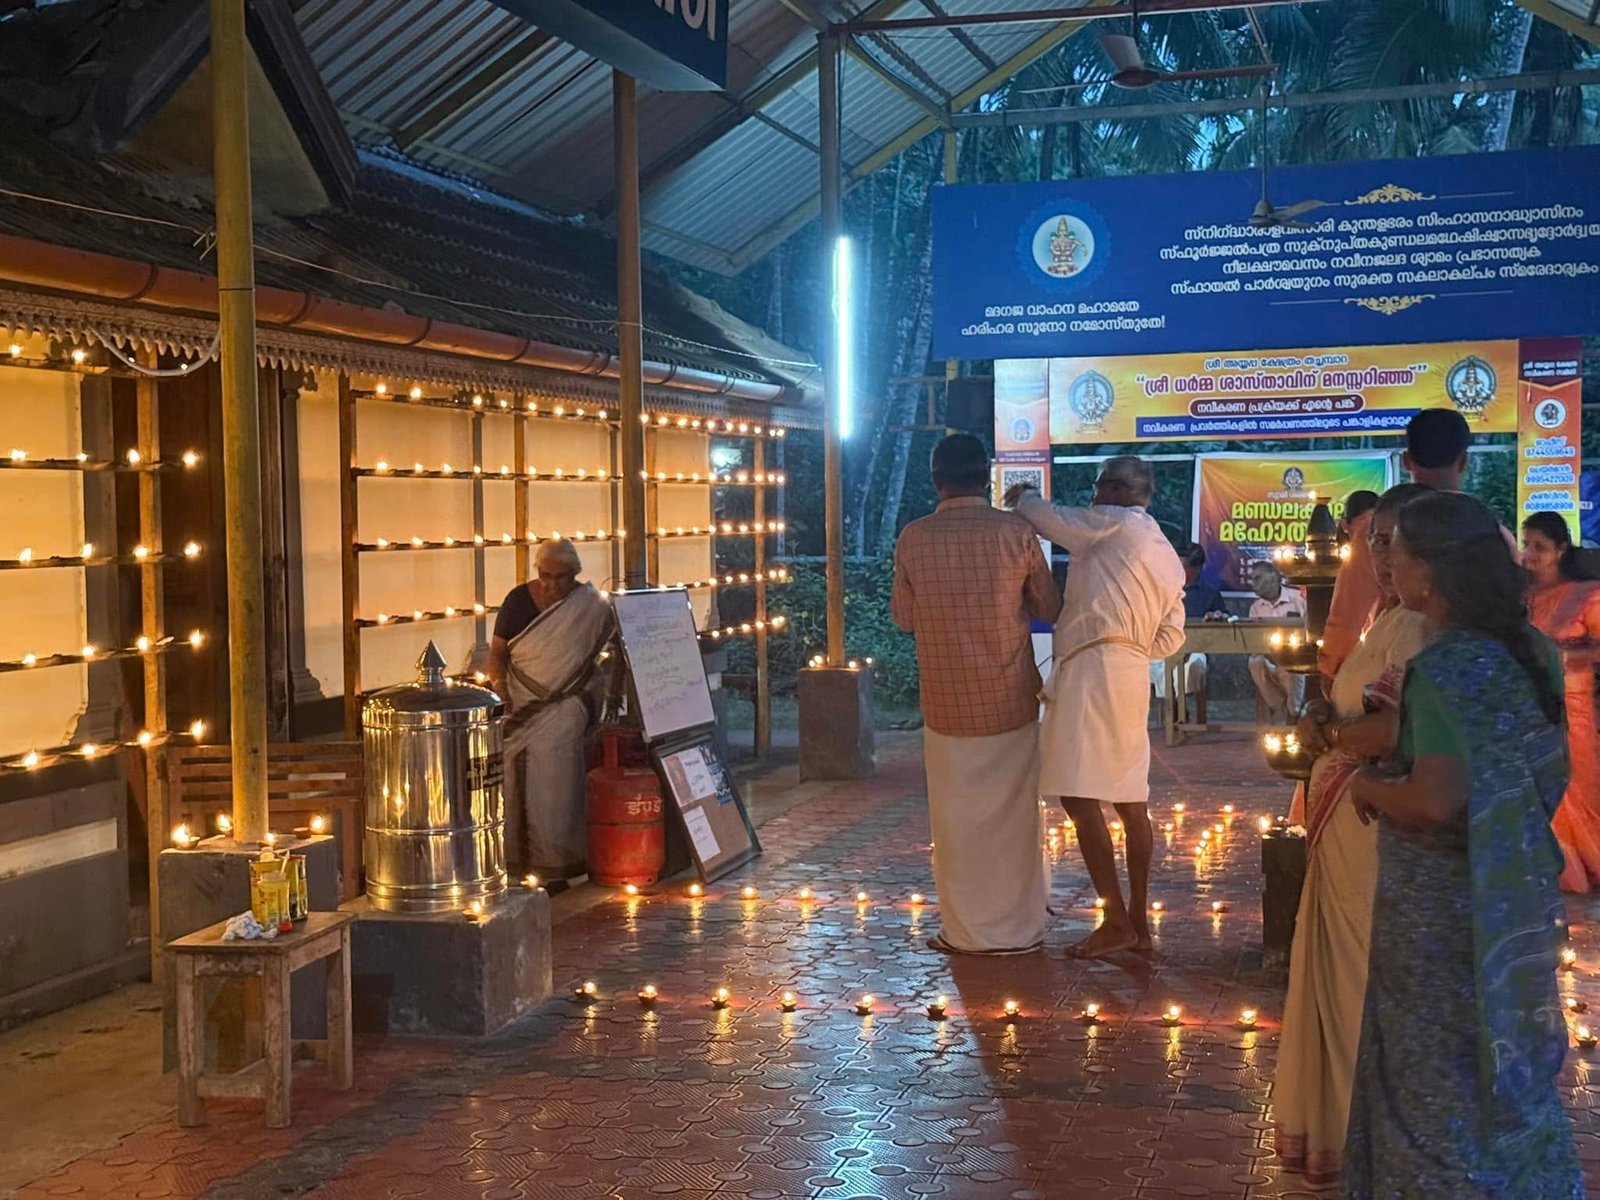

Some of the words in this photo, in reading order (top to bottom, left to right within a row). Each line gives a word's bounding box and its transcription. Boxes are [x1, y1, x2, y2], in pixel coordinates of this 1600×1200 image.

[1410, 251, 1453, 267] ശ്യാമം
[1027, 303, 1075, 316] വാഹന
[1078, 300, 1140, 314] മഹാമതേ
[961, 321, 1014, 336] ഹരിഹര
[1017, 319, 1066, 336] സൂനോ
[1070, 315, 1165, 332] നമോസ്തുതേ!
[1175, 375, 1213, 392] ധർമ്മ
[1219, 370, 1319, 391] ശാസ്താവിന്
[1197, 401, 1246, 413] നവീകരണ
[1143, 422, 1185, 433] നവീകരണ
